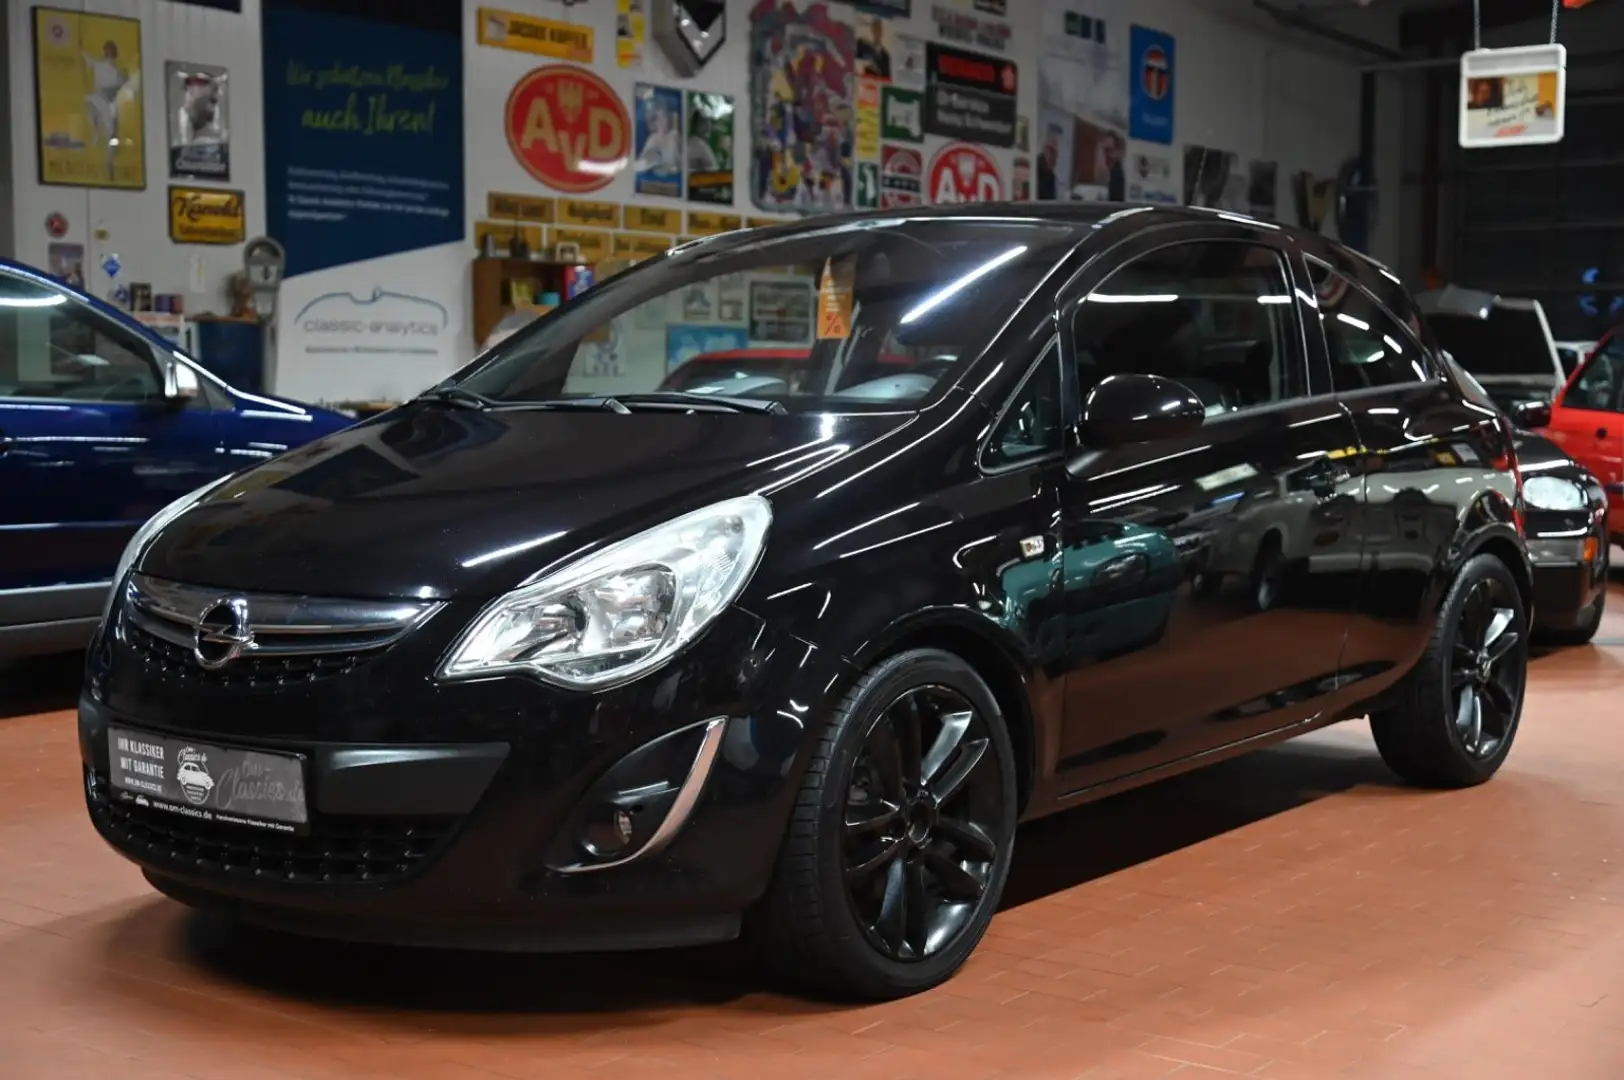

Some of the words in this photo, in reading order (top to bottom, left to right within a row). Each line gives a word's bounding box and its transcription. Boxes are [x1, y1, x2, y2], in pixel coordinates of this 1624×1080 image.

[301, 92, 360, 131] auch
[363, 92, 436, 136] Ihren!
[118, 737, 129, 752] IHR
[129, 740, 165, 760] KLASSIKER
[120, 756, 132, 772] MIT
[133, 760, 165, 779] GARANTIE
[153, 801, 212, 820] www.om-classics.de
